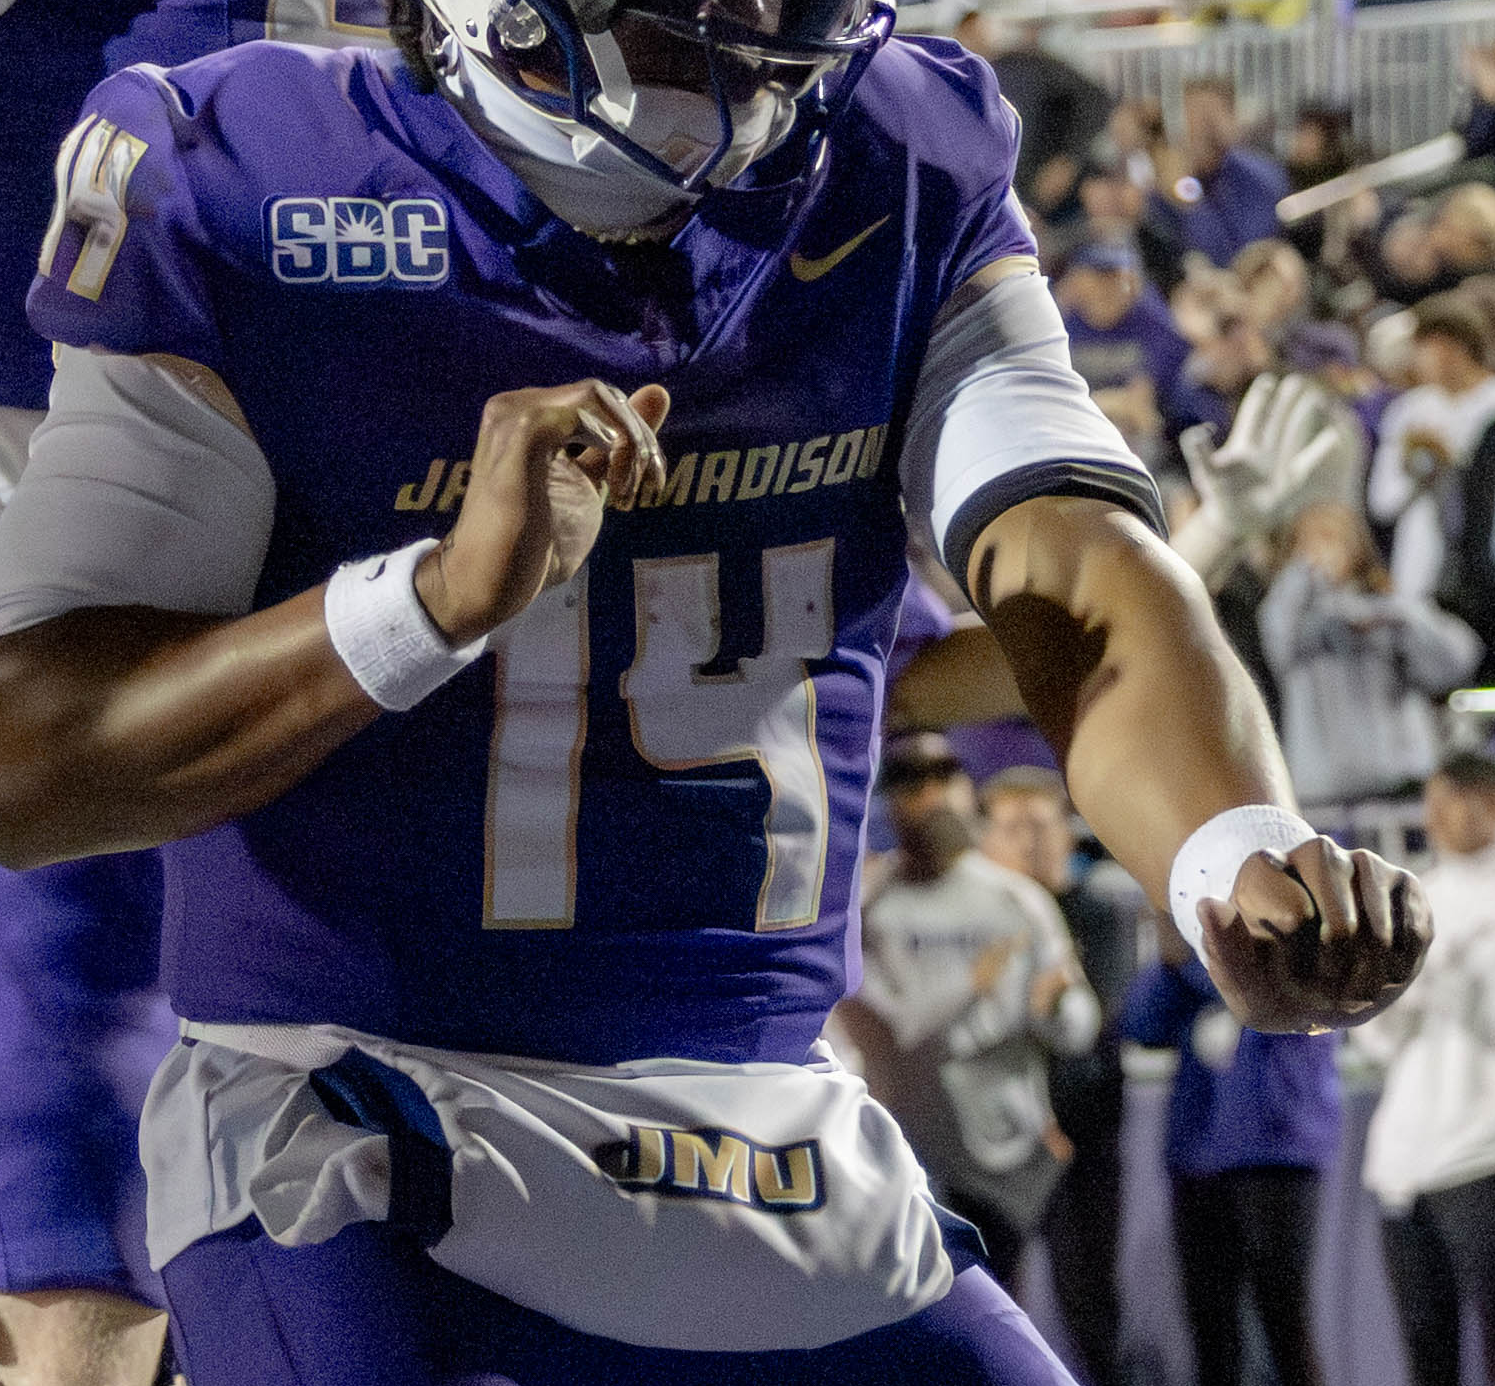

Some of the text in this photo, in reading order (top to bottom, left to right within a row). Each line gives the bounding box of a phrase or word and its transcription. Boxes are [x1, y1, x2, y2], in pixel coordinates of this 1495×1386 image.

[40, 113, 150, 302] 14
[270, 196, 450, 284] SBC
[636, 423, 888, 511] MADISON
[482, 536, 836, 934] 14
[604, 1124, 824, 1209] JMU
